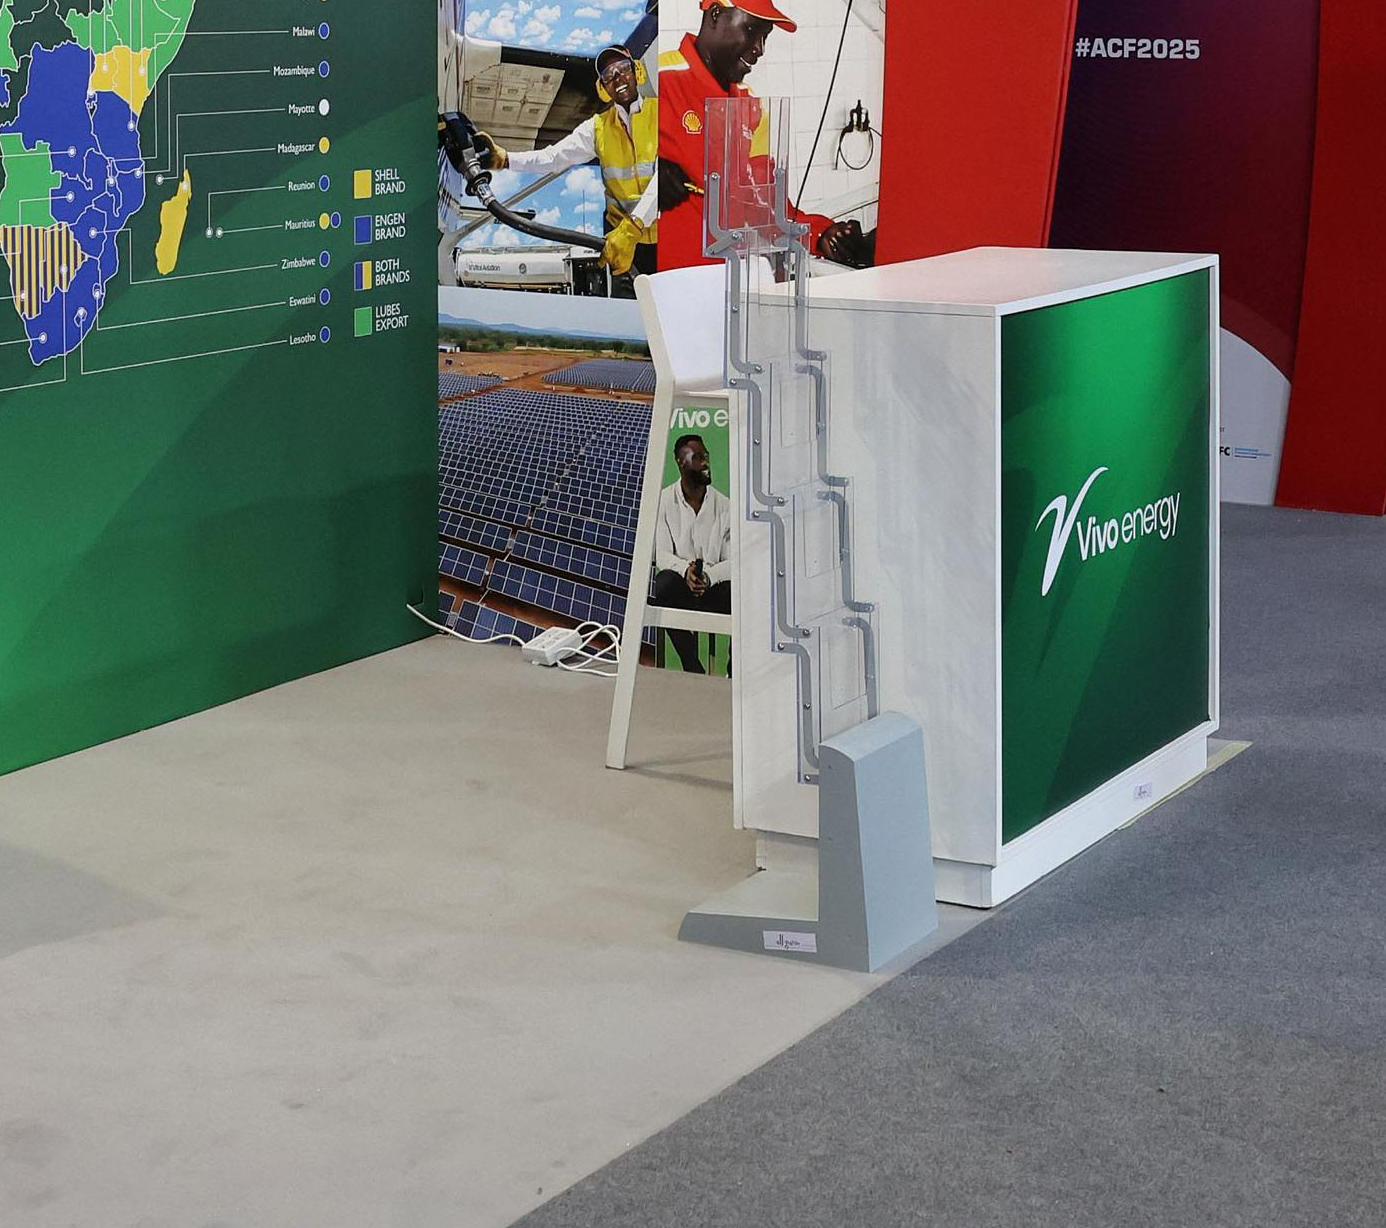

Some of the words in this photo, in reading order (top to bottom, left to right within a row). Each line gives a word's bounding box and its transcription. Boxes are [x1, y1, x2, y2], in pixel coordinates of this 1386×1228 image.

[292, 26, 315, 37] Malawi
[1075, 37, 1201, 60] #ACF2025
[273, 65, 315, 78] Mozambique
[288, 103, 315, 117] Mayotte
[277, 142, 315, 155] Madagascar
[374, 168, 400, 182] SHELL
[288, 180, 315, 193] Reunion
[375, 181, 406, 196] BRAND
[285, 219, 315, 231] Mauritius
[375, 212, 406, 226] ENGEN
[375, 226, 406, 240] BRAND
[281, 257, 316, 270] Zimbabwe
[375, 258, 400, 273] BOTH
[375, 270, 410, 286] BRANDS
[289, 294, 316, 307] Eswatini
[376, 303, 401, 318] LUBES
[376, 315, 409, 332] EXPORT
[289, 333, 317, 346] Lesotho
[1076, 516, 1119, 561] Vivo
[1121, 492, 1180, 544] energy
